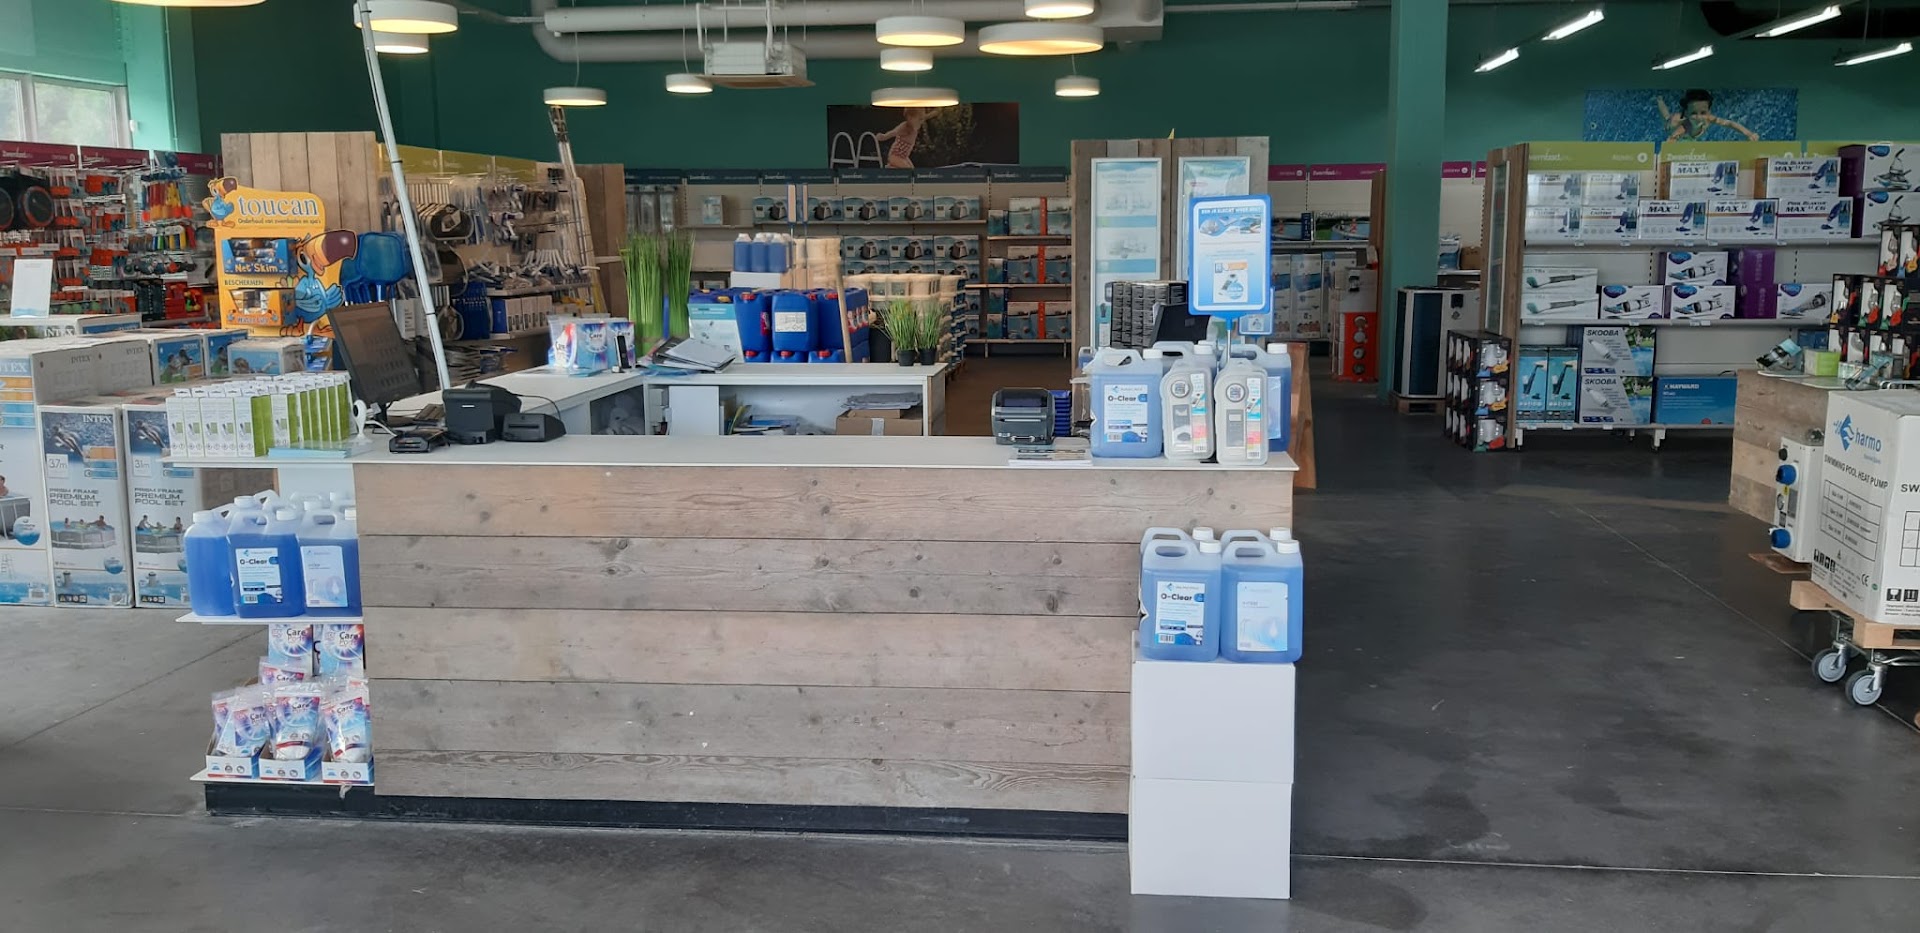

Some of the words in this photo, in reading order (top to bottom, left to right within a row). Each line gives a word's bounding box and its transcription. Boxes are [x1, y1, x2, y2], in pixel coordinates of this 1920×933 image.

[239, 196, 319, 216] toucan
[0, 363, 27, 373] TEX
[83, 415, 112, 423] INTEX
[1855, 428, 1882, 452] harmo
[1845, 464, 1857, 478] POOL
[1858, 471, 1870, 482] HEAT
[1870, 476, 1889, 489] PUMP
[1900, 484, 1920, 493] SW
[135, 492, 180, 500] PREMIUM
[1161, 593, 1192, 601] O-Clear
[287, 628, 306, 636] Care
[340, 632, 358, 640] Care
[337, 704, 353, 713] Care
